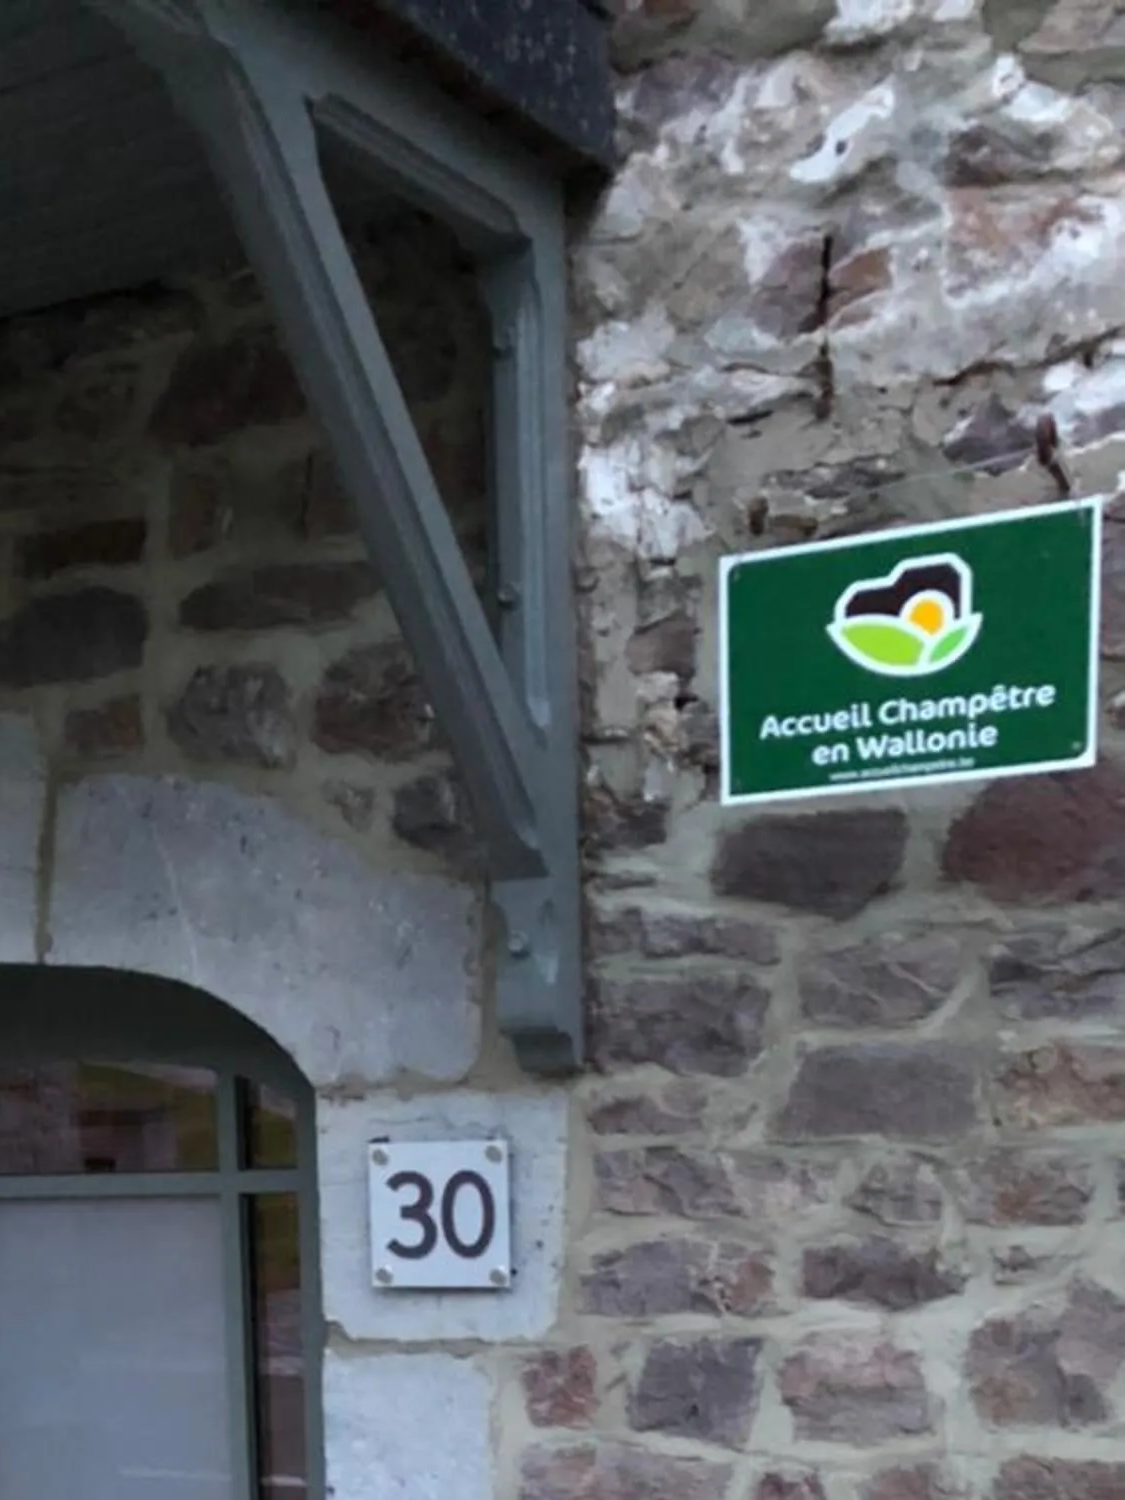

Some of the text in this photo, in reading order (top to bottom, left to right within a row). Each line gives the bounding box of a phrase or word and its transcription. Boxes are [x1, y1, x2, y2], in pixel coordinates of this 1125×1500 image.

[759, 684, 1056, 740] Accueil Champêtre
[811, 723, 998, 765] en Wallonie
[386, 1169, 495, 1260] 30
